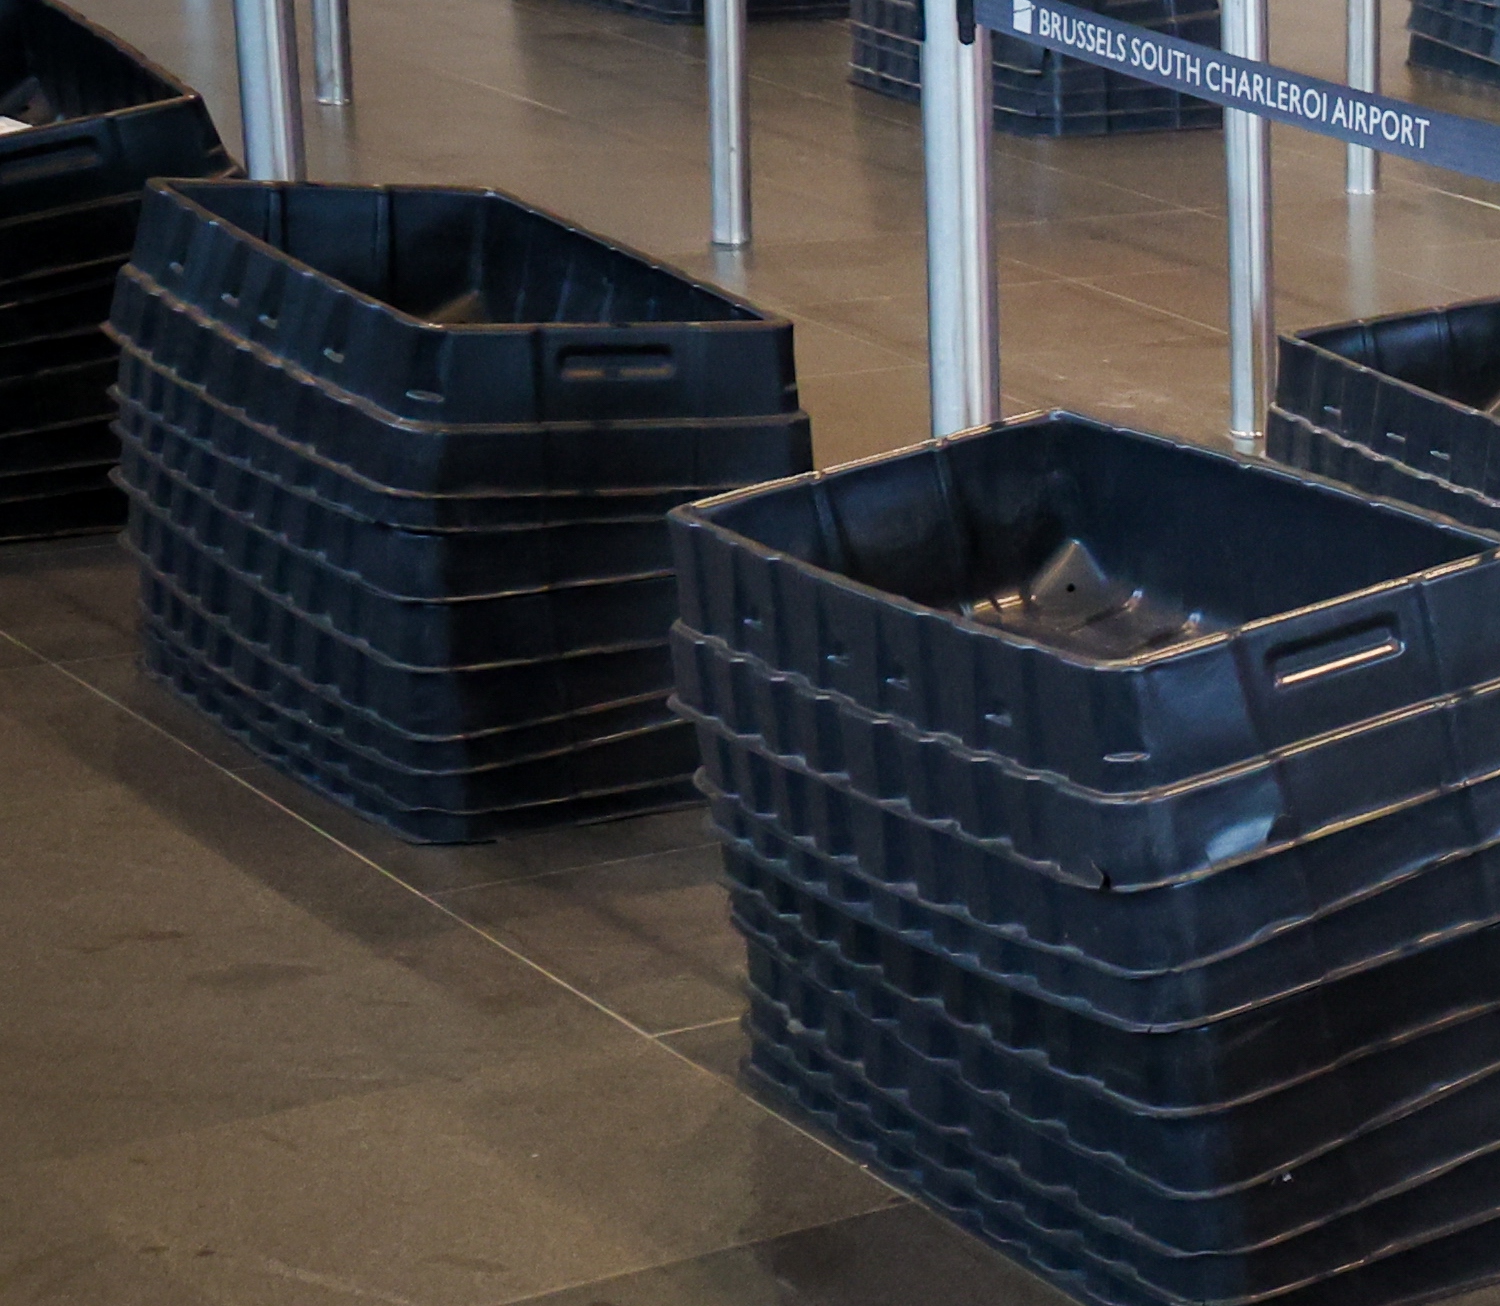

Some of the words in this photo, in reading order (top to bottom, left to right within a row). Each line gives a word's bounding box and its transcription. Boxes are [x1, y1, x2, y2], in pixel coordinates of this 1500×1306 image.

[1038, 7, 1126, 64] BRUSSELS
[1130, 39, 1200, 87] SOUTH
[1206, 64, 1328, 122] CHARLEROI
[1333, 100, 1430, 150] AIRPORT
